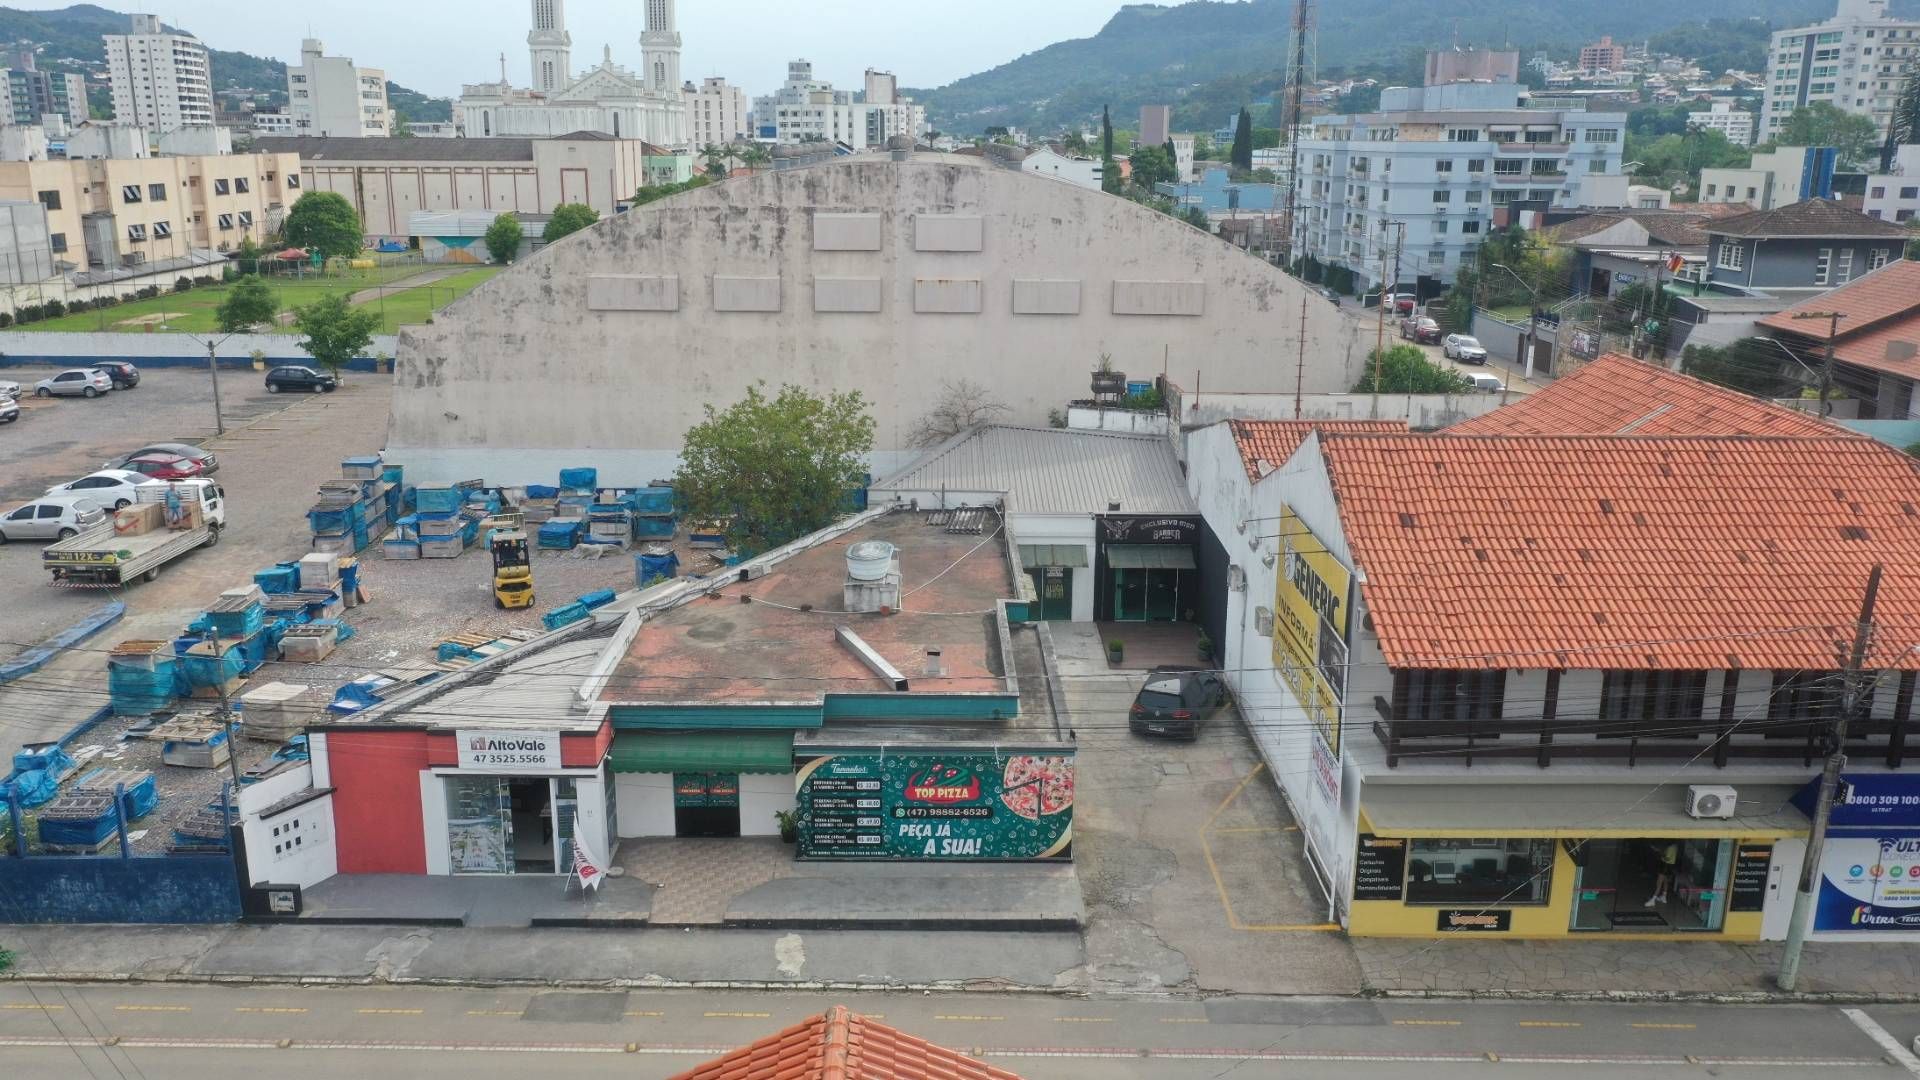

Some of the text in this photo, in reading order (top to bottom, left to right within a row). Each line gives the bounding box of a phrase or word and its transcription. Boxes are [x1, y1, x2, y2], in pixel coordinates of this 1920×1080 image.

[74, 552, 98, 561] 12X
[1278, 593, 1316, 652] INFORMÁ
[487, 740, 546, 751] AltoVale
[473, 754, 546, 764] 47 3525.5566
[915, 788, 969, 798] TOP PIZZA
[1878, 796, 1899, 805] 309
[1901, 796, 1920, 805] 100
[907, 808, 927, 817] (47)
[898, 823, 932, 840] PEÇA
[934, 820, 951, 837] JÁ
[923, 837, 982, 855] A SUA!
